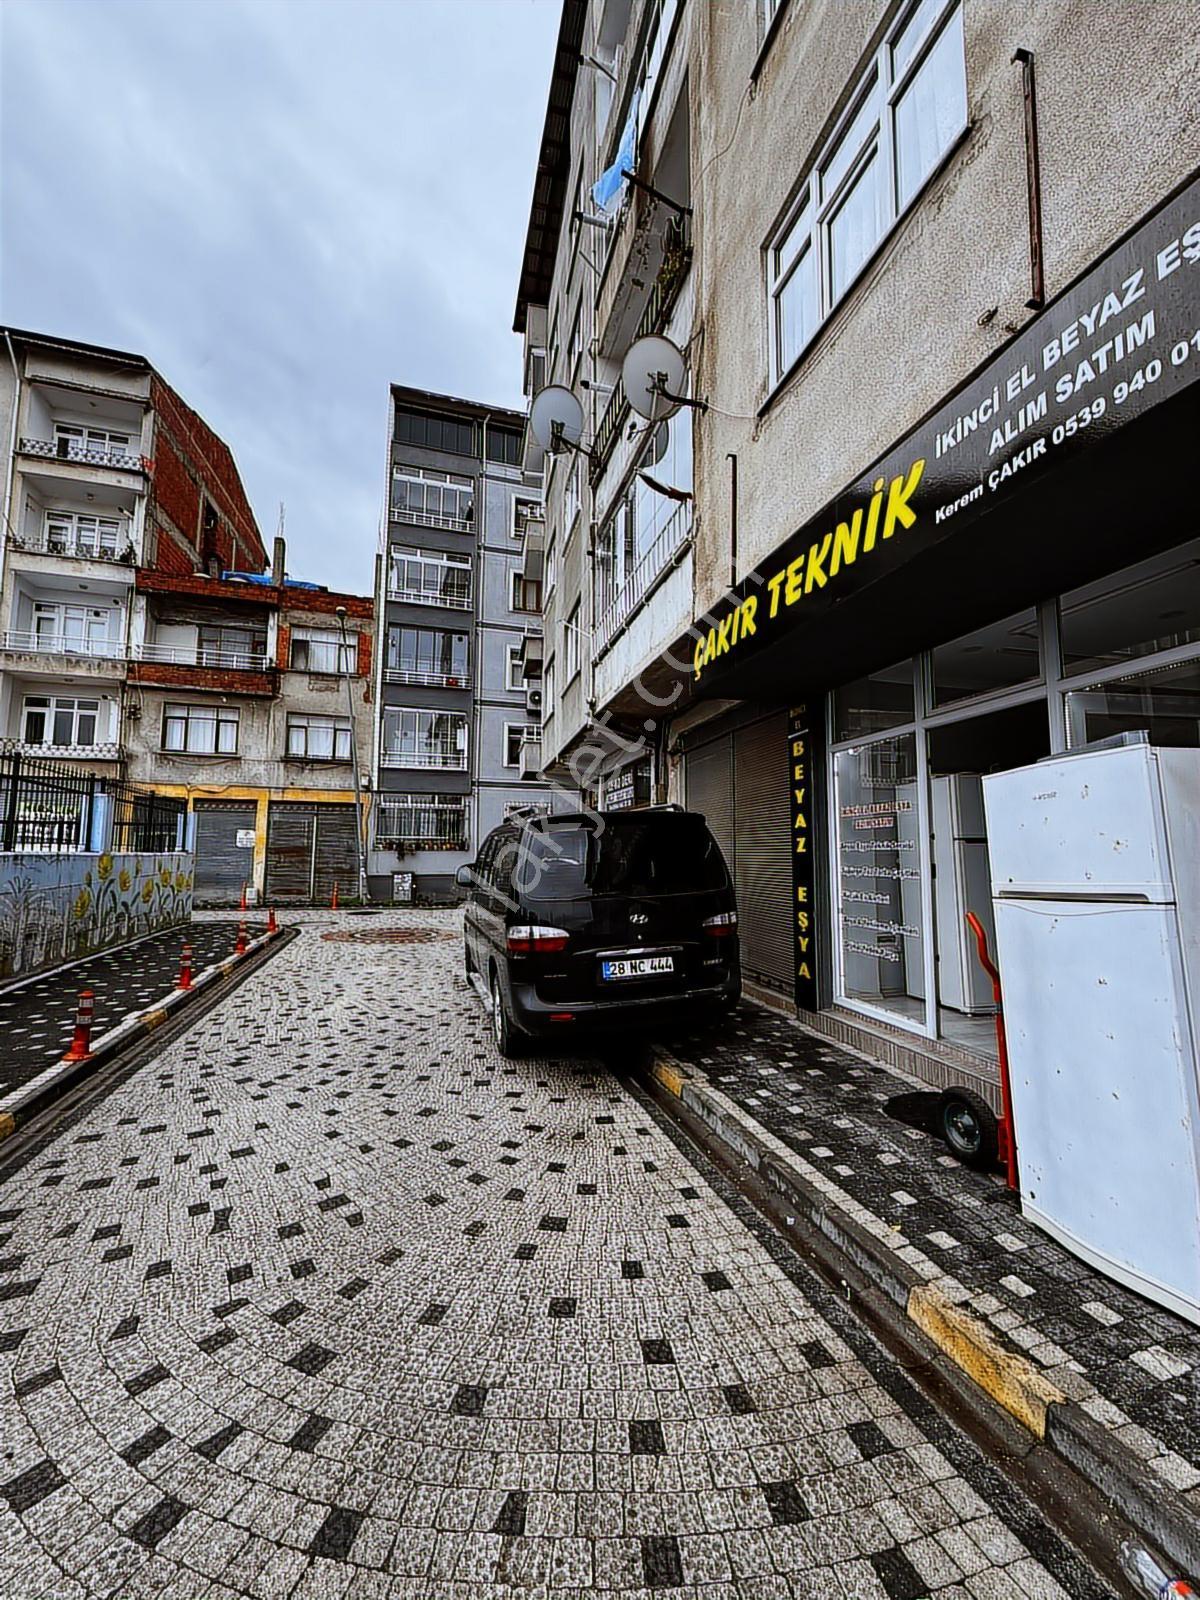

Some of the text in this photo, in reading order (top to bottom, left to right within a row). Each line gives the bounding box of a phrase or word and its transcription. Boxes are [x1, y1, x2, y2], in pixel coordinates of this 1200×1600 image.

[934, 384, 1000, 459] İKİNCİ
[1006, 363, 1036, 403] EL
[1042, 267, 1146, 371] BEYAZ
[988, 309, 1156, 456] ALIM SATIM
[935, 484, 984, 525] Kerem
[988, 438, 1047, 492] ÇAKIR
[1052, 397, 1106, 446] 0539
[1112, 359, 1162, 405] 940
[693, 458, 926, 681] ÇAKIR TEKNİK
[793, 741, 807, 854] BEYAZ
[610, 957, 673, 976] 28 NC 444
[797, 886, 811, 980] EŞYA
